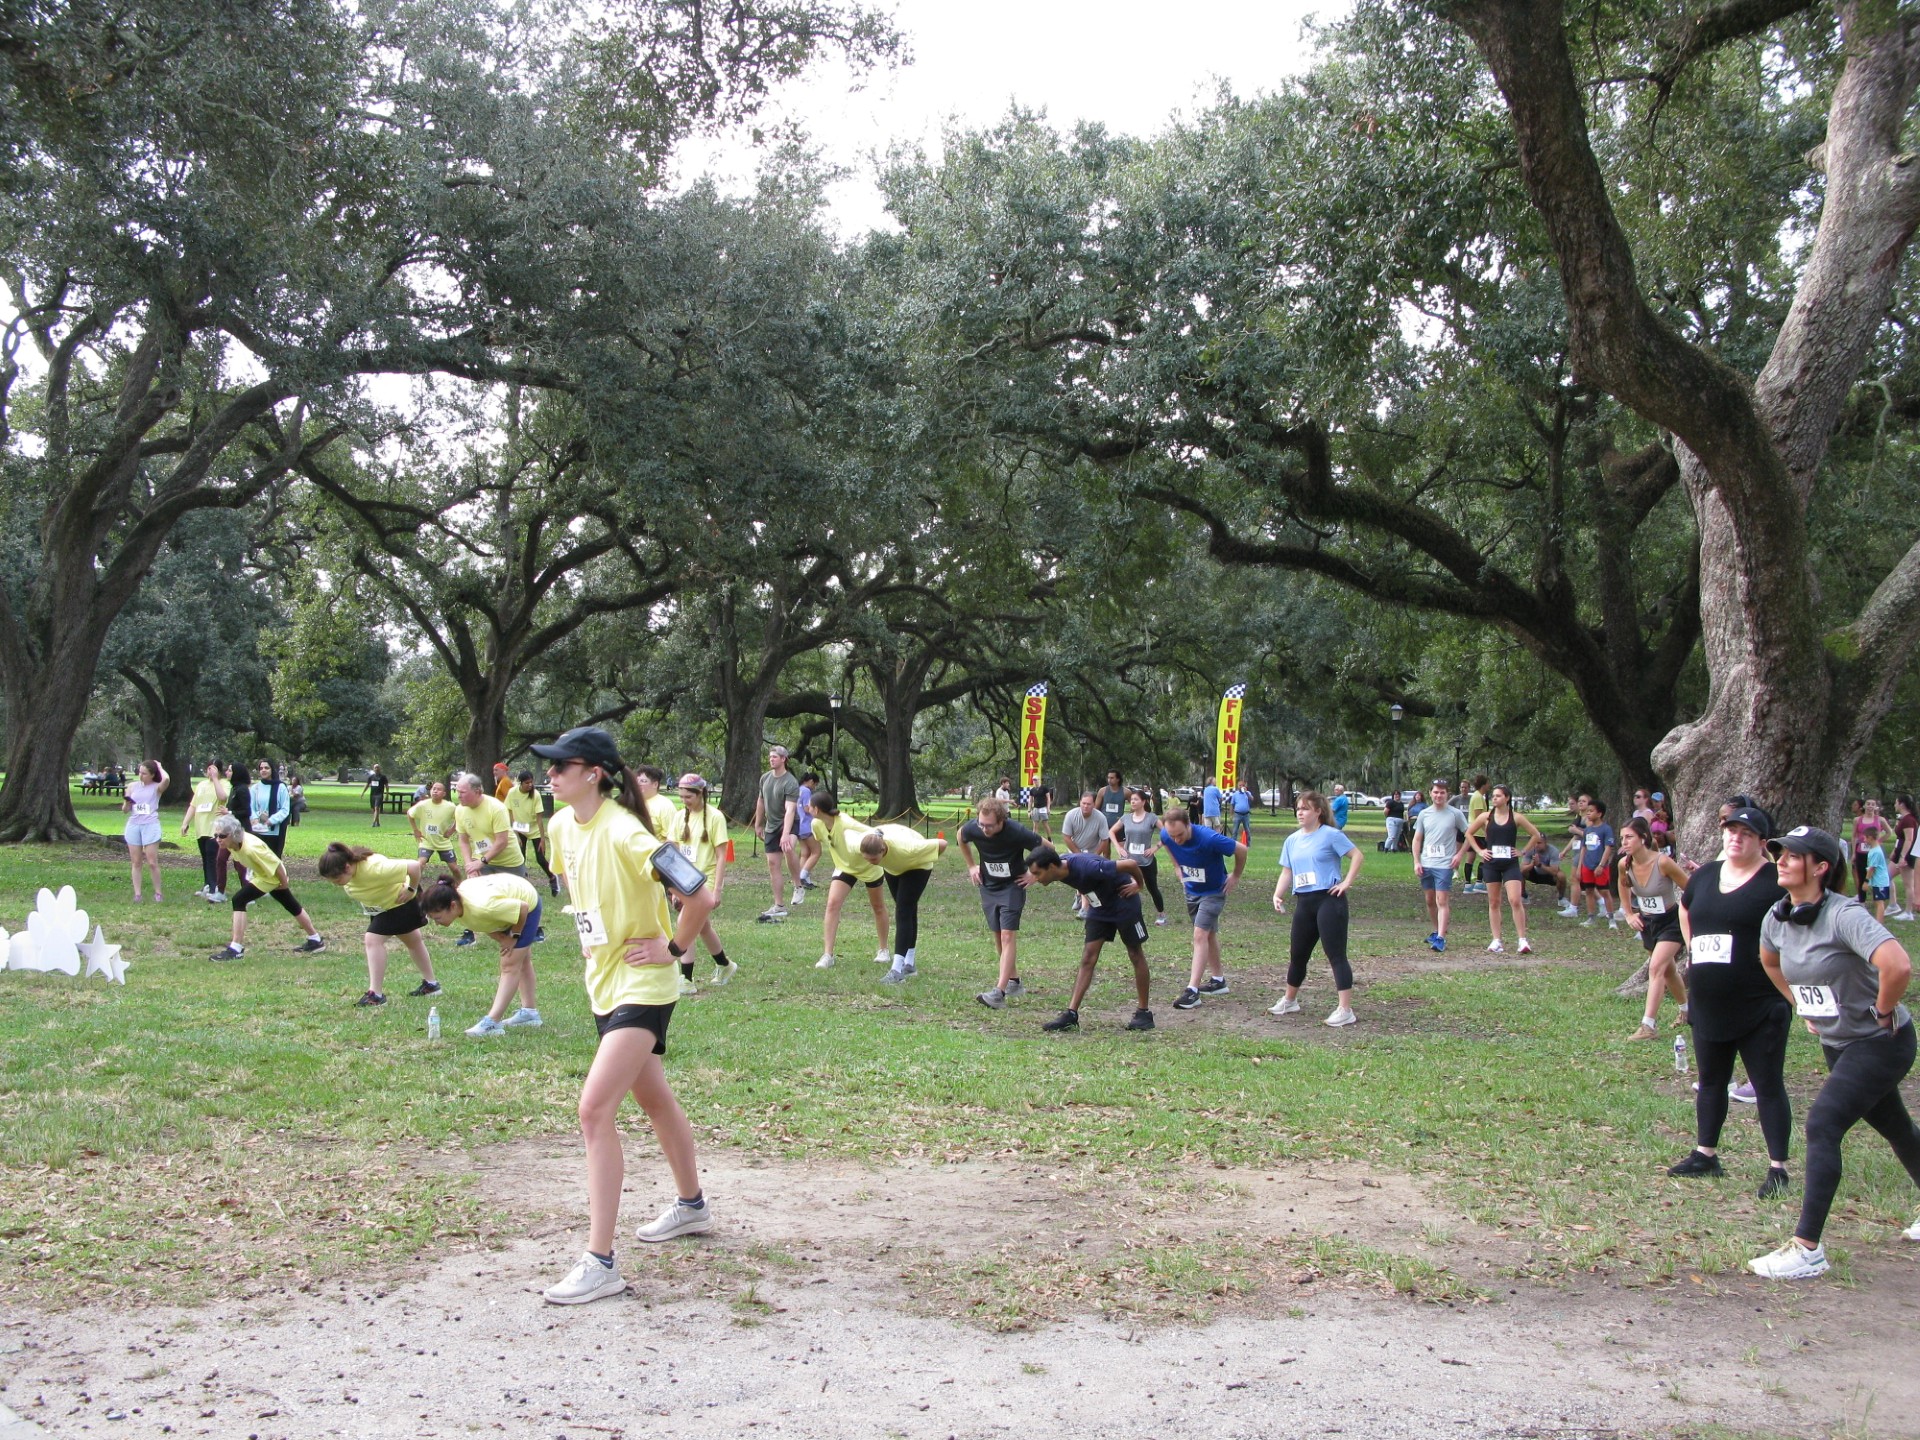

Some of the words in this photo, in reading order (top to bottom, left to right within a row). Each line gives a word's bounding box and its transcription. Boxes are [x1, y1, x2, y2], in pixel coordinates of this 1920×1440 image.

[1024, 697, 1042, 785] START
[1222, 700, 1238, 789] FINISH
[990, 864, 1004, 872] 608
[1699, 935, 1721, 952] 678
[1799, 985, 1824, 1004] 679
